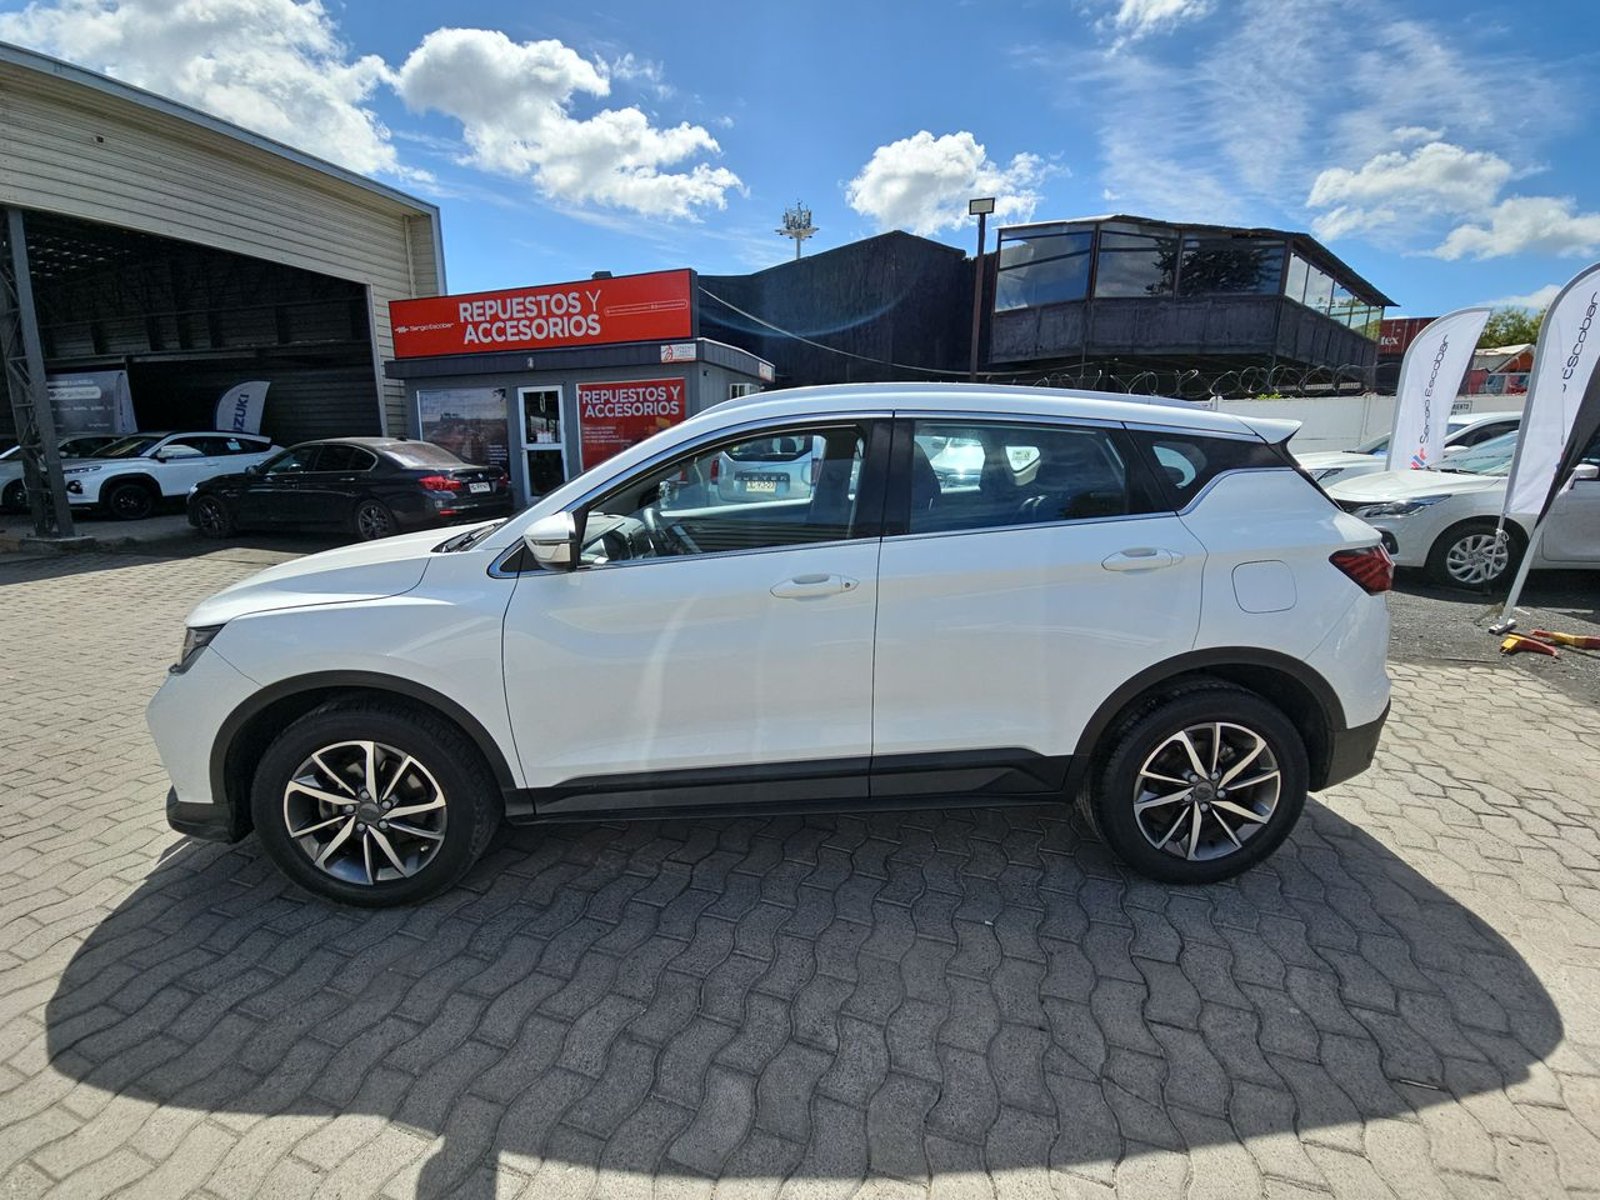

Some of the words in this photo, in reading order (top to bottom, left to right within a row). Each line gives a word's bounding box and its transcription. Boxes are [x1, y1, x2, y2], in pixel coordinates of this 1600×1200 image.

[459, 292, 581, 323] REPUESTOS
[585, 289, 601, 312] Y
[463, 313, 601, 345] ACCESORIOS
[1424, 334, 1448, 397] Escobar
[582, 387, 667, 405] REPUESTOS
[669, 385, 681, 401] Y
[584, 401, 680, 418] ACCESORIOS
